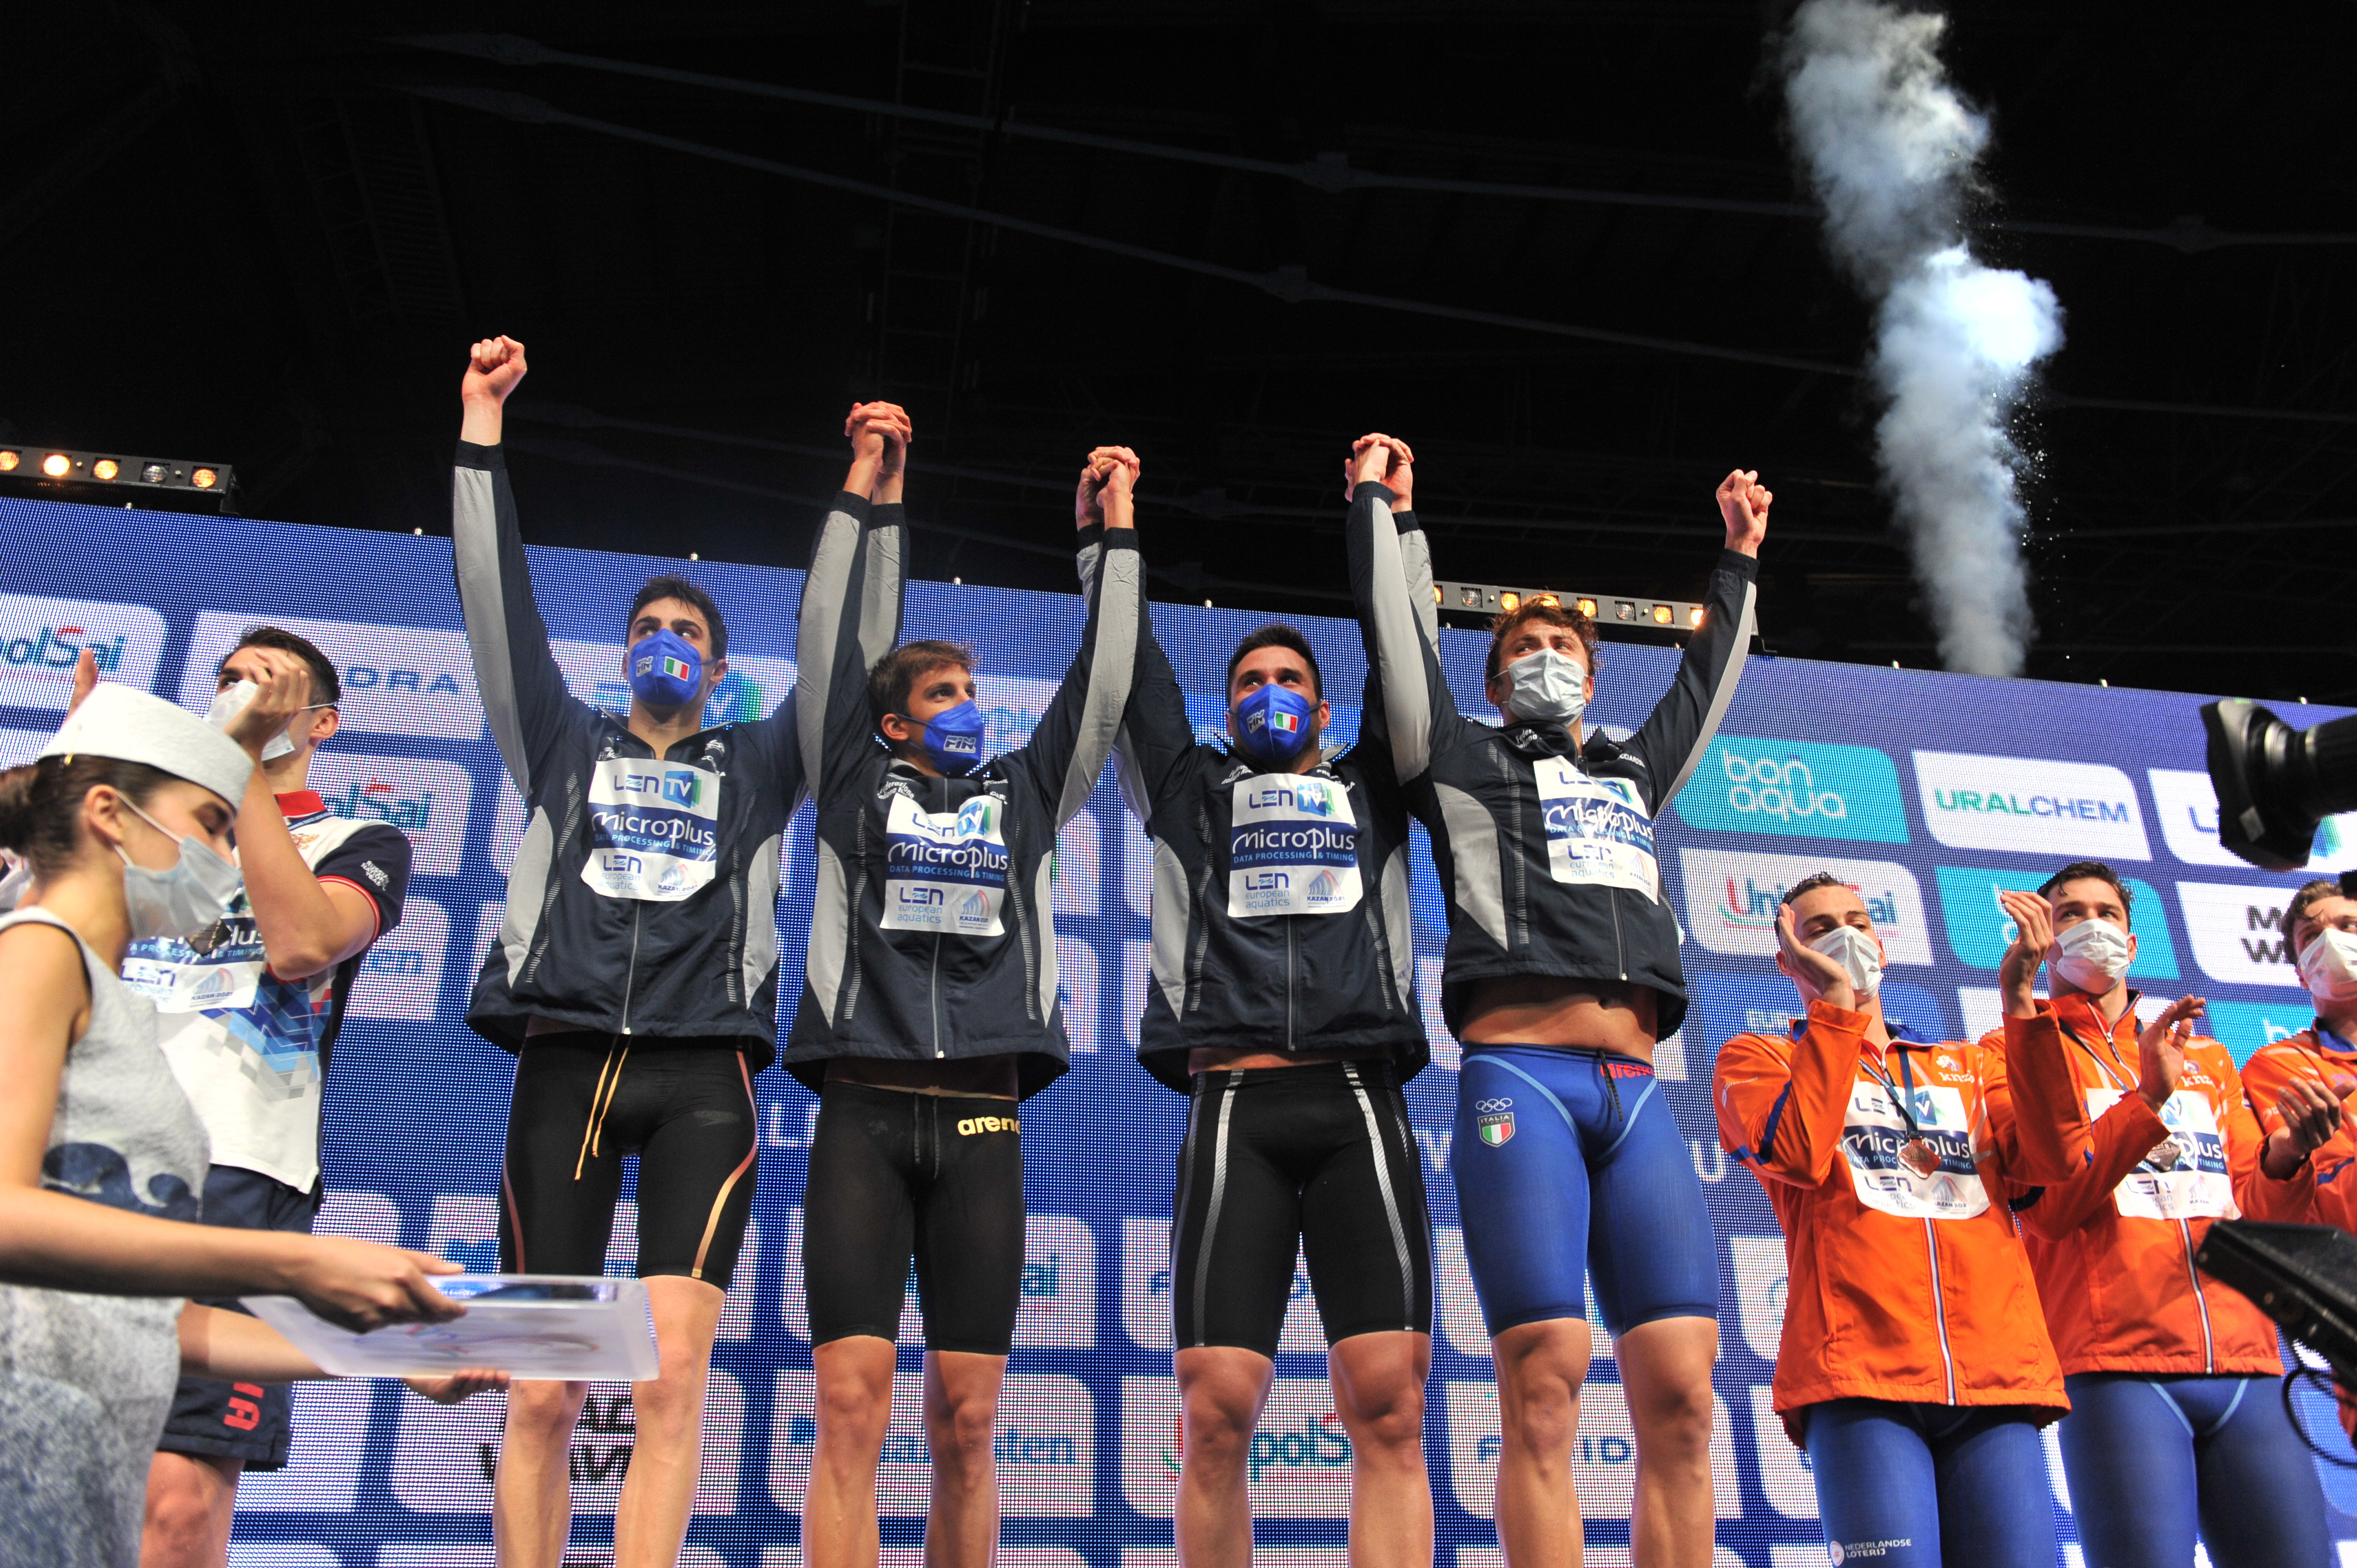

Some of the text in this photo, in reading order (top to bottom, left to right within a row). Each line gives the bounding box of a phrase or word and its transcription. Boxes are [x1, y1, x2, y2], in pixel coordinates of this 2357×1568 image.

[944, 736, 976, 750] FIN
[666, 777, 692, 797] TV
[1249, 790, 1293, 809] LEN
[1934, 790, 2129, 823] URALCHEM
[958, 811, 982, 831] TV
[611, 834, 670, 848] PROCESSING
[1234, 855, 1253, 864] DATA
[1255, 852, 1312, 861] PROCESSING
[1326, 852, 1354, 862] TIMING
[912, 866, 970, 877] PROCESSING
[982, 872, 1005, 881] TIMING
[1246, 873, 1289, 890] LEN
[899, 887, 944, 905] LEN
[1246, 890, 1289, 899] european
[898, 905, 942, 914] european
[1246, 898, 1290, 909] aquatics
[897, 913, 941, 924] aquatics
[1480, 1115, 1510, 1123] ITALIA
[1944, 1158, 1972, 1169] TIMING
[2199, 1158, 2224, 1169] TIMING
[1845, 1539, 1912, 1551] NEDERLANDSE
